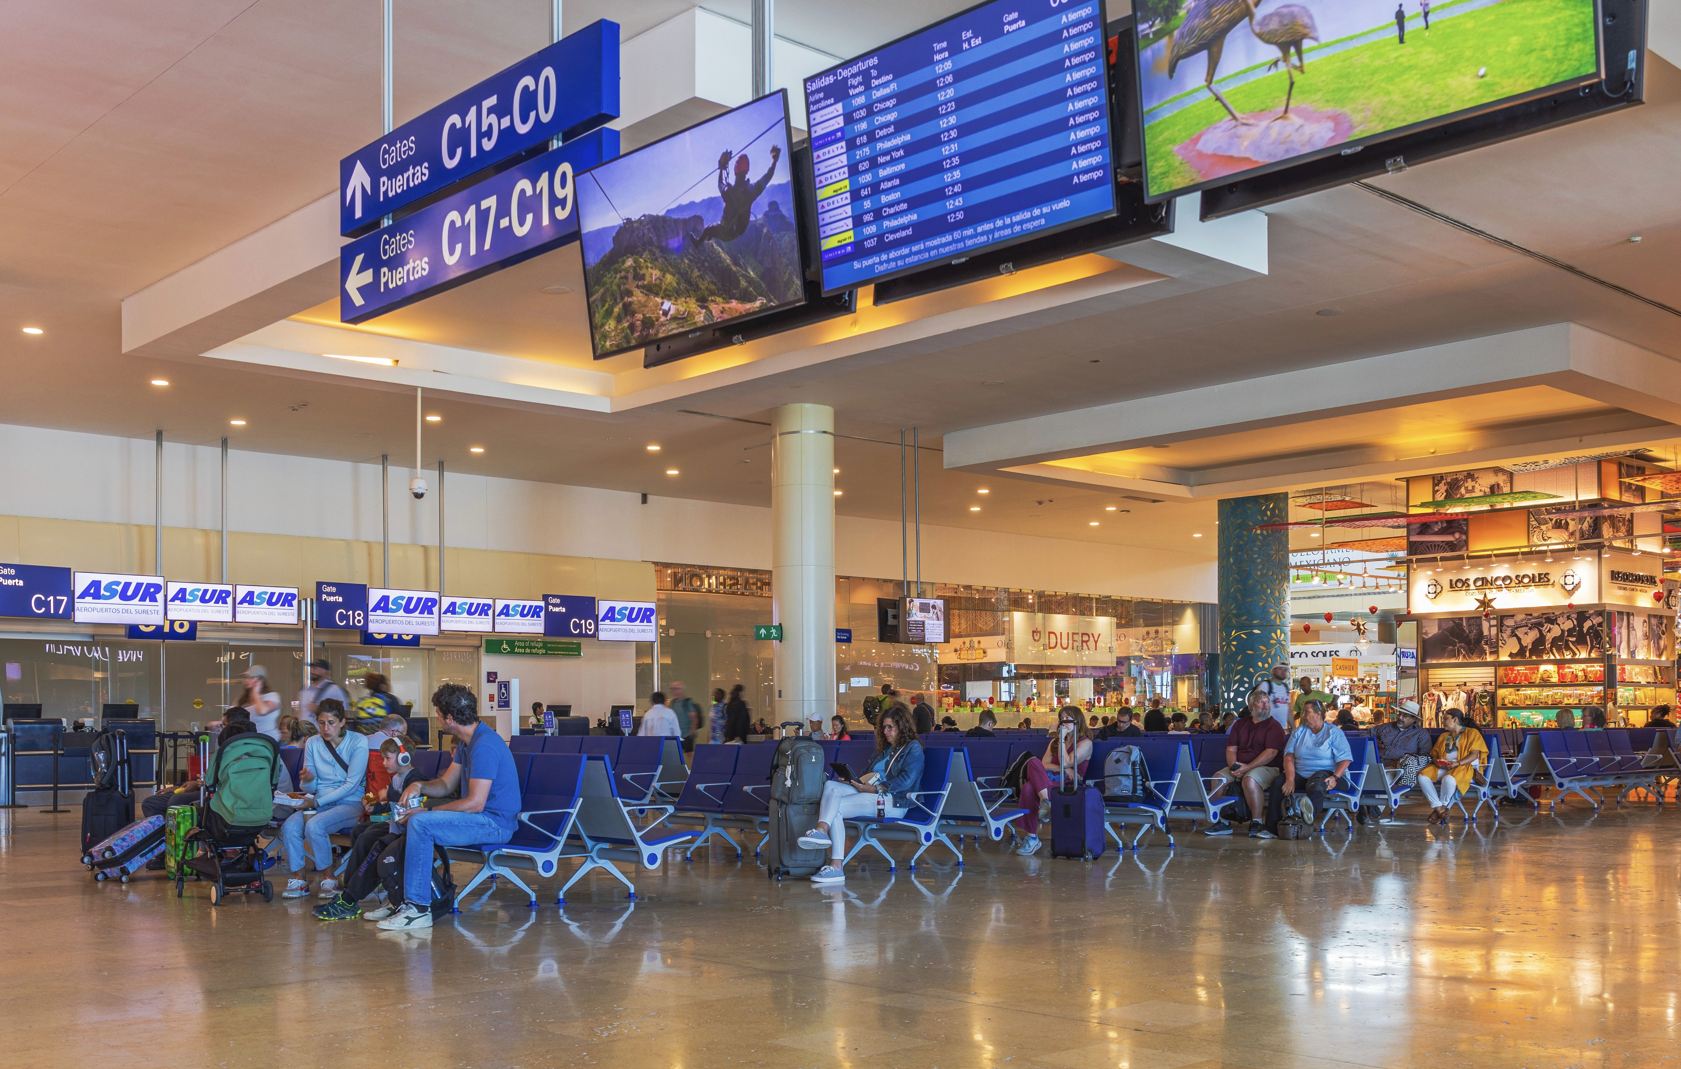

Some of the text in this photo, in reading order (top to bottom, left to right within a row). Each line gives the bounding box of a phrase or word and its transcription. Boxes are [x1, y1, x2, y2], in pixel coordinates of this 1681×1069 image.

[1062, 14, 1068, 24] A
[1068, 6, 1092, 21] tiempo
[848, 75, 862, 87] Flight
[870, 69, 878, 77] To
[933, 41, 948, 51] Time
[1003, 11, 1019, 23] Gate
[848, 85, 865, 96] Vuelo
[871, 74, 893, 87] Destino
[933, 51, 949, 62] Hora
[1004, 19, 1026, 34] Puerta
[873, 98, 897, 112] Chicago
[1062, 29, 1068, 39] A
[1069, 21, 1093, 36] tiempo
[874, 111, 898, 125] Chicago
[937, 87, 955, 101] 12:20
[1064, 44, 1069, 54] A
[1070, 36, 1094, 51] tiempo
[441, 65, 557, 170] C15-C0
[822, 145, 844, 156] DELTA
[875, 125, 895, 139] Detroit
[938, 101, 956, 115] 12:23
[1065, 58, 1070, 68] A
[1071, 51, 1095, 65] tiempo
[876, 133, 911, 151] Philadelphia
[939, 115, 957, 129] 12:30
[1066, 73, 1072, 83] A
[1072, 66, 1096, 80] tiempo
[824, 169, 847, 182] DELTA
[877, 154, 891, 165] New
[891, 149, 905, 159] York
[940, 128, 958, 142] 12:30
[1067, 88, 1073, 98] A
[1073, 81, 1097, 95] tiempo
[878, 163, 906, 177] Baltimore
[941, 142, 958, 155] 12:31
[1068, 103, 1074, 112] A
[1074, 96, 1098, 110] tiempo
[379, 135, 416, 169] Gates
[826, 195, 849, 207] DELTA
[880, 178, 900, 190] Atlanta
[942, 156, 960, 169] 12:35
[1069, 117, 1075, 126] A
[1076, 110, 1099, 124] tiempo
[881, 191, 901, 203] Boston
[943, 169, 961, 182] 12:35
[1070, 132, 1076, 142] A
[1076, 125, 1100, 139] tiempo
[379, 161, 430, 202] Puertas
[882, 202, 908, 216] Charlotte
[944, 183, 962, 196] 12:40
[1071, 146, 1077, 156] A
[1078, 140, 1101, 153] tiempo
[883, 213, 918, 229] Philadelphia
[1072, 160, 1078, 170] A
[1078, 155, 1102, 168] tiempo
[441, 161, 574, 266] C17-C19
[884, 227, 913, 242] Cleveland
[947, 210, 964, 223] 12:50
[1073, 175, 1079, 184] A
[1080, 170, 1103, 183] tiempo
[380, 228, 416, 261] Gates
[853, 260, 862, 270] Su
[862, 255, 880, 268] puerta
[880, 252, 888, 260] de
[888, 247, 911, 259] abordar
[925, 234, 953, 247] mostrada
[976, 223, 994, 233] antes
[995, 218, 1004, 227] de
[1004, 216, 1011, 225] la
[1012, 210, 1031, 223] salida
[1032, 207, 1041, 216] de
[1042, 205, 1051, 214] su
[1051, 199, 1071, 211] vuelo
[897, 258, 905, 266] su
[905, 250, 929, 264] estancia
[929, 249, 938, 257] en
[938, 240, 965, 255] nuestras
[965, 233, 988, 246] tiendas
[988, 232, 993, 242] y
[1013, 223, 1022, 233] de
[1022, 217, 1046, 231] espera
[380, 254, 430, 293] Puertas
[76, 579, 163, 603] ASUR
[168, 587, 232, 605] ASUR
[322, 584, 337, 593] Gate
[1449, 572, 1551, 590] LOS CINCO SOLES
[31, 593, 68, 614] C17
[76, 606, 120, 614] AEROPUERTOS
[134, 608, 160, 616] SURESTE
[237, 590, 297, 607] ASUR
[322, 594, 343, 603] Puerta
[369, 595, 438, 615] ASUR
[442, 601, 492, 617] ASUR
[496, 603, 544, 618] ASUR
[548, 596, 561, 604] Gate
[548, 605, 566, 613] Puerta
[600, 606, 656, 624] ASUR
[335, 609, 364, 627] C18
[570, 618, 595, 634] C19
[1047, 631, 1101, 651] DUFRY
